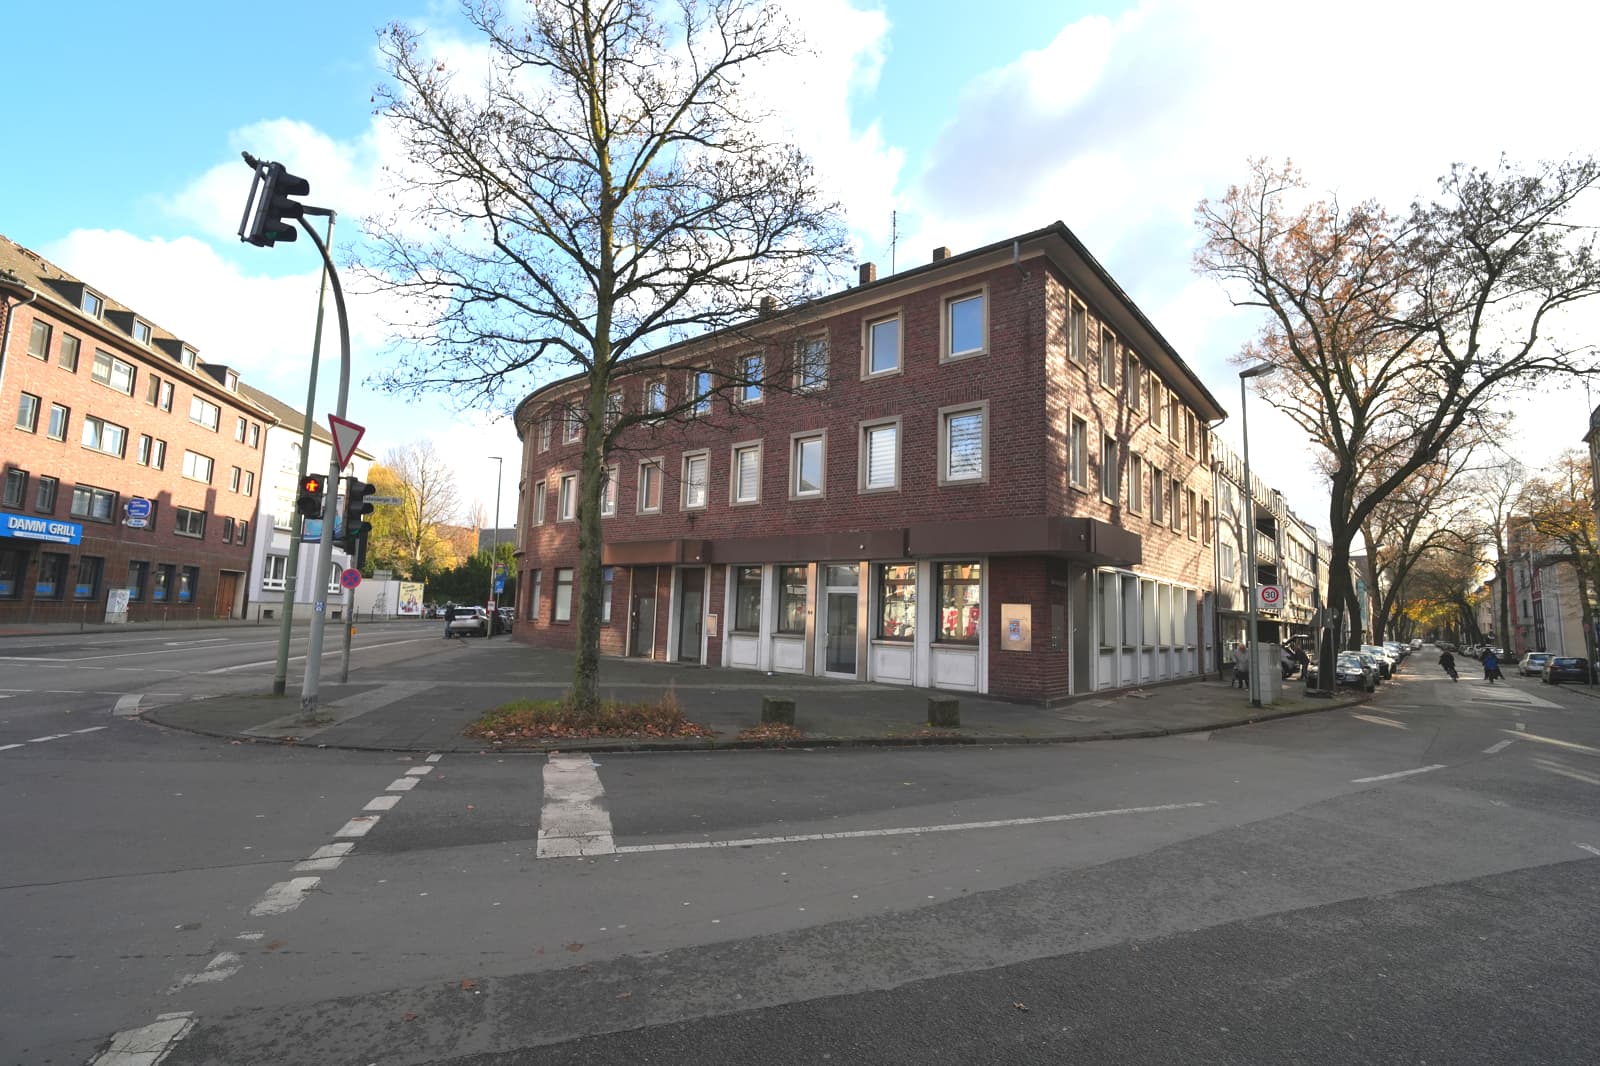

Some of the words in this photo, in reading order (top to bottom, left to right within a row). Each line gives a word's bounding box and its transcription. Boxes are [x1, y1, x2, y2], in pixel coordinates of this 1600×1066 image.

[8, 517, 46, 533] DAMM
[49, 523, 76, 537] GRILL
[1265, 591, 1276, 599] 30
